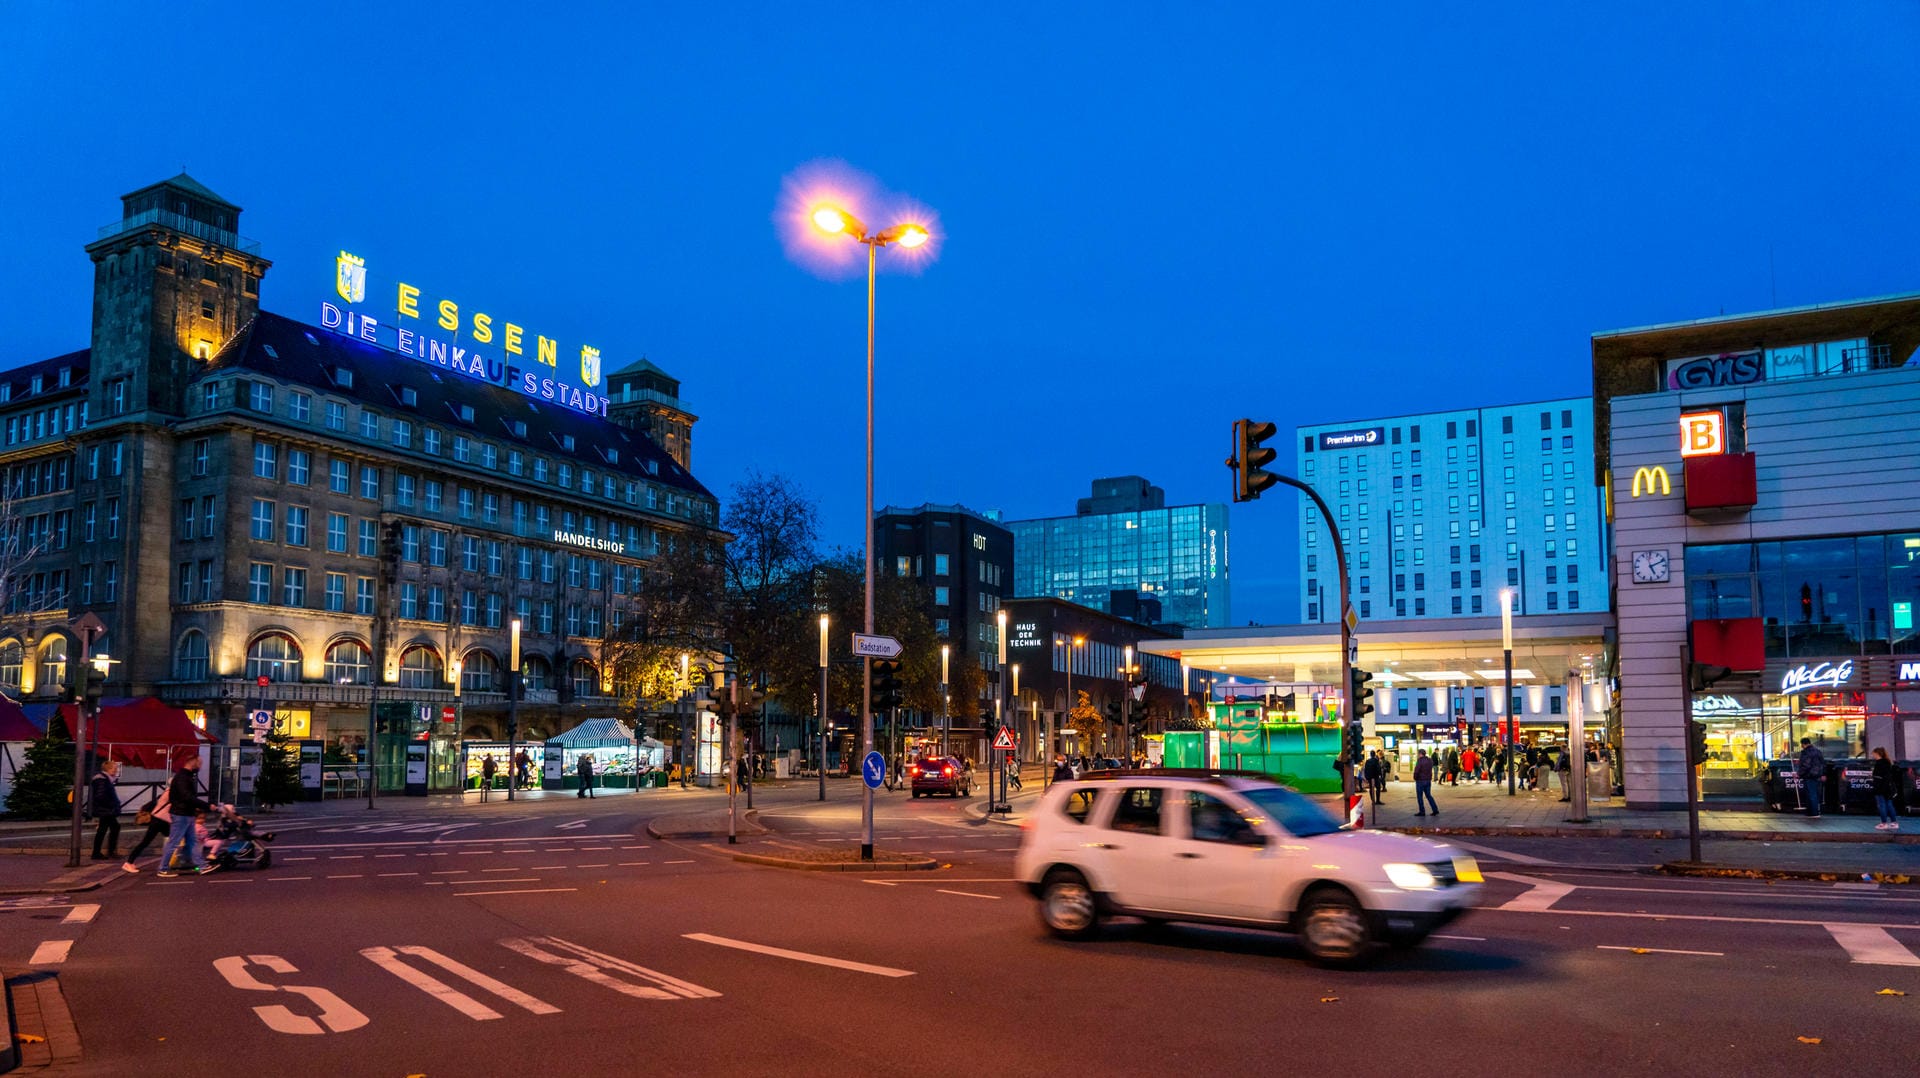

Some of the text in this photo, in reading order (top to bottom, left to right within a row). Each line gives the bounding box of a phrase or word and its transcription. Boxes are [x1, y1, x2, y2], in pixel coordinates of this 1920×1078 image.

[398, 282, 557, 367] ESSEN
[321, 302, 610, 417] DIE EINKAUFSSTADT
[554, 529, 625, 553] HANDELSHOF
[973, 532, 987, 551] HDT
[1016, 623, 1036, 631] HAUS
[1019, 631, 1033, 639] DER
[860, 641, 891, 653] Radstation
[1009, 639, 1042, 647] TECHNIK
[421, 707, 432, 721] U
